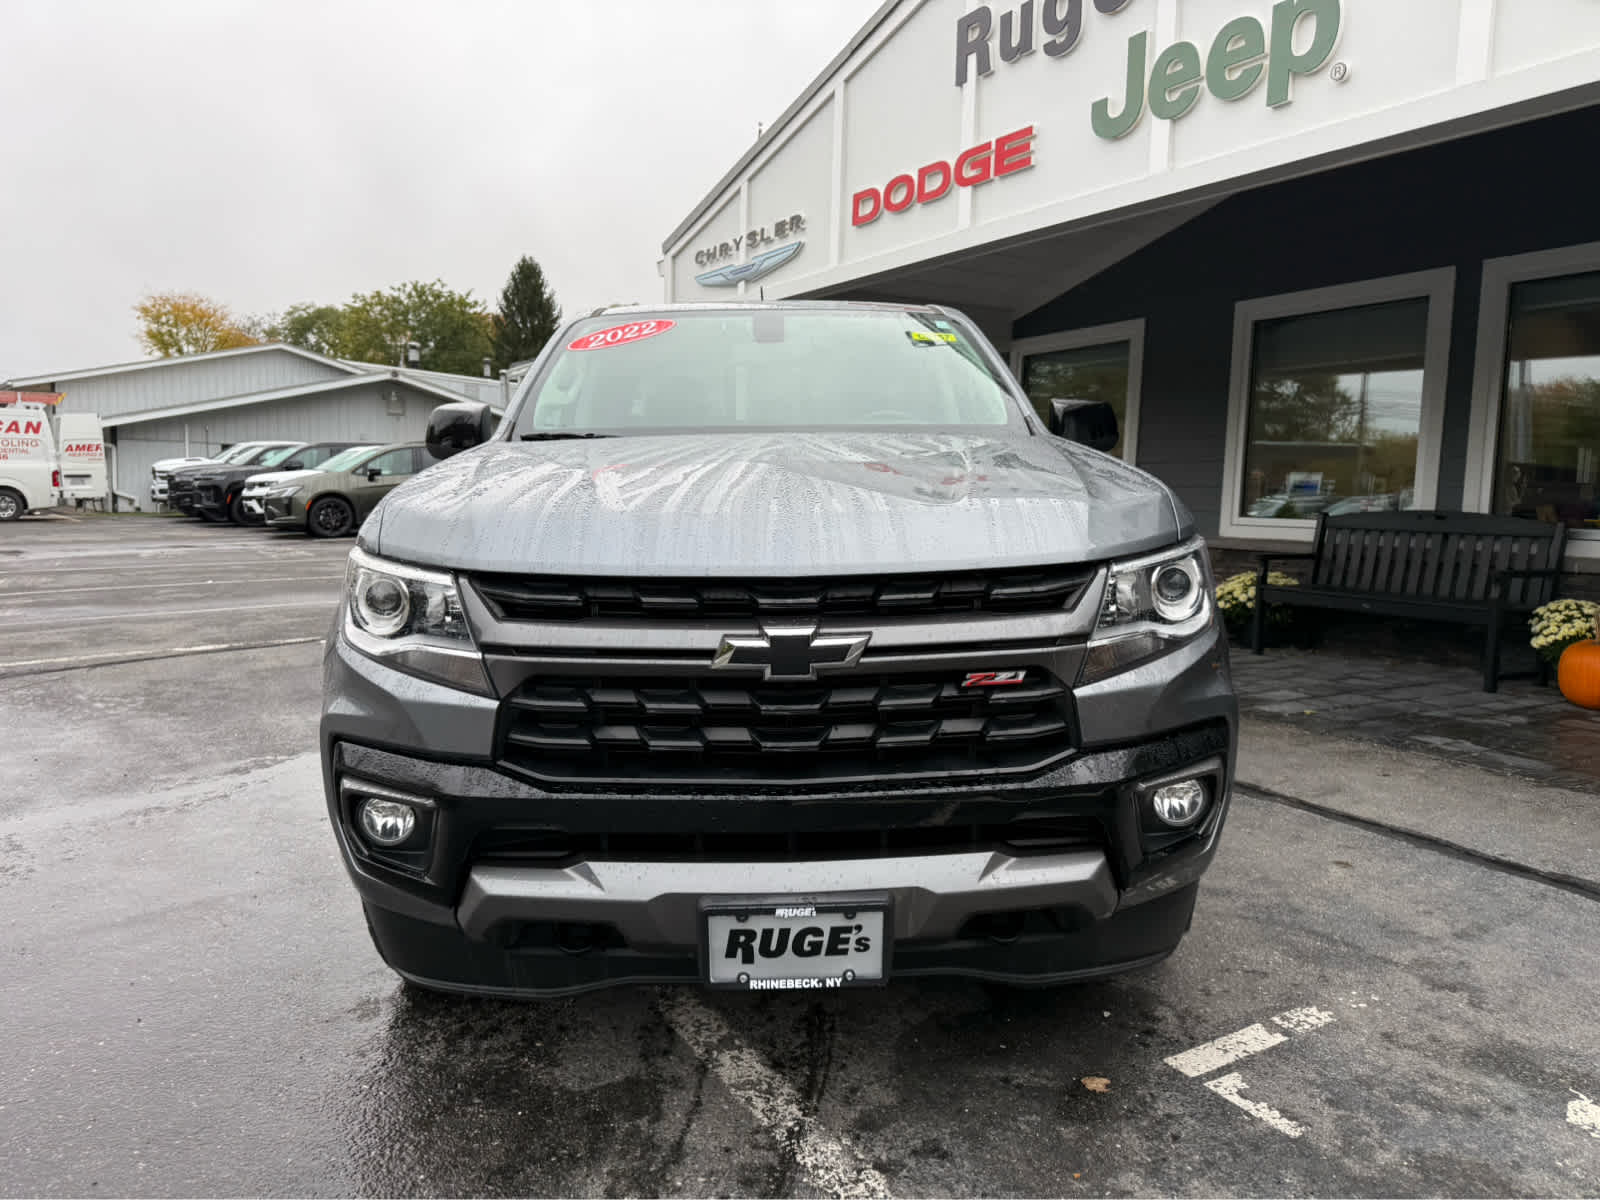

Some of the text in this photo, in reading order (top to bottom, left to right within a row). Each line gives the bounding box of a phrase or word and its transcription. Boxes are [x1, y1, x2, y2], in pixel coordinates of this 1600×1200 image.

[956, 0, 1130, 87] Rug
[1091, 0, 1341, 139] Jeep
[852, 125, 1035, 227] DODGE
[695, 215, 805, 265] CHRYSLER
[588, 321, 657, 348] 2022
[0, 420, 42, 434] AN
[961, 670, 1026, 687] Z71
[725, 924, 871, 964] RUGE's
[826, 977, 842, 988] NY
